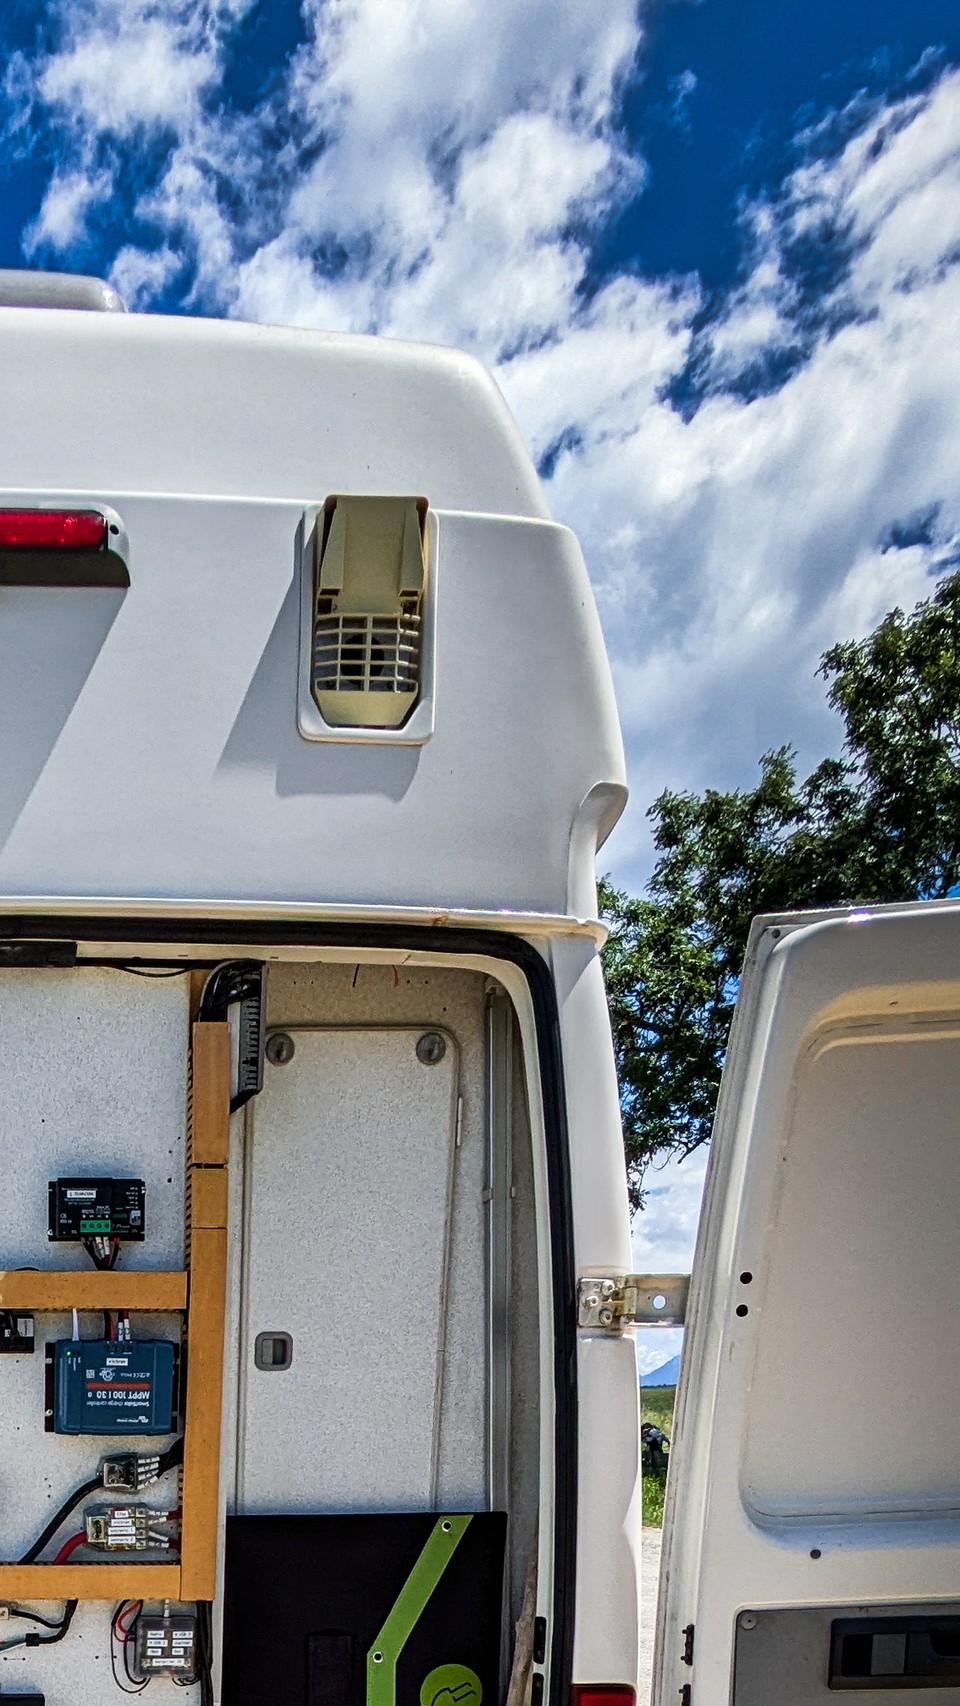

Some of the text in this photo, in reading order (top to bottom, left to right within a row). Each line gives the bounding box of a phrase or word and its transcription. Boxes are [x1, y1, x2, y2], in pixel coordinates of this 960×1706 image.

[96, 1391, 107, 1399] 30
[113, 1391, 126, 1399] 100
[127, 1391, 150, 1399] MPPT
